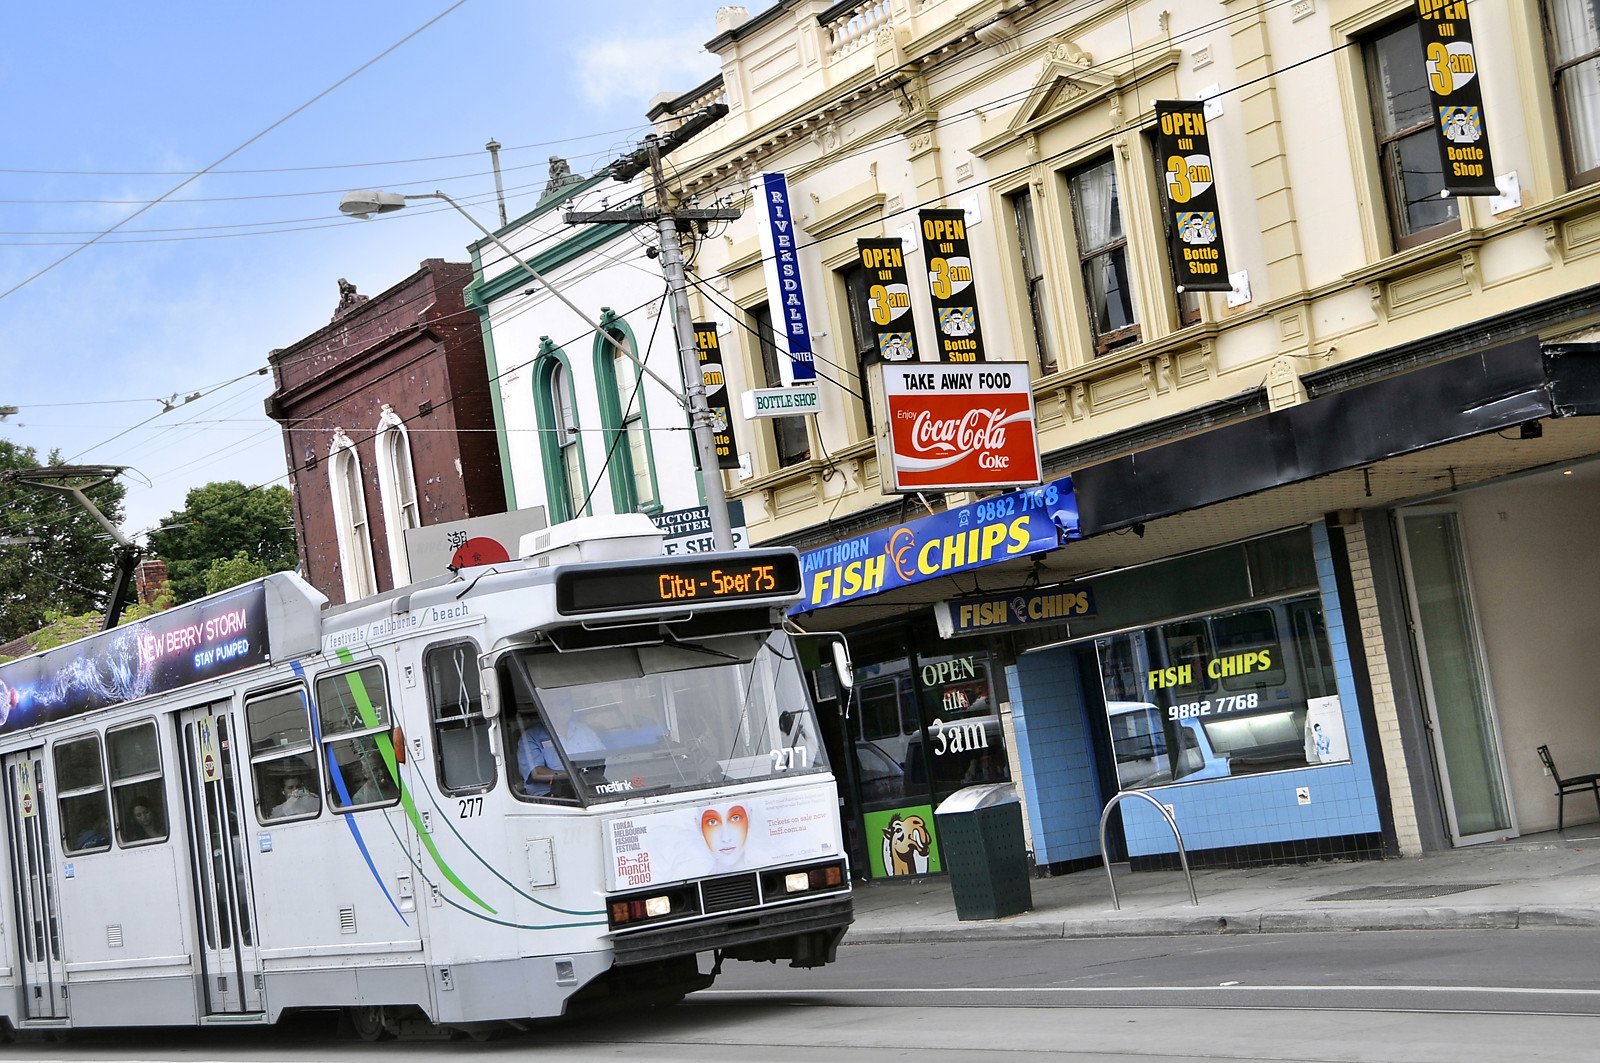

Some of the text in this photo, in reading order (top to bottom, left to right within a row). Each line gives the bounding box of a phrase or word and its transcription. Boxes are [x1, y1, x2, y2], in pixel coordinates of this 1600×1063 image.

[1419, 0, 1467, 19] OPEN
[1438, 23, 1454, 36] till
[1161, 112, 1205, 136] OPEN
[1177, 138, 1193, 150] till
[1447, 146, 1483, 161] Bottle
[1453, 162, 1483, 177] Shop
[923, 219, 965, 240] OPEN
[940, 242, 954, 253] till
[1183, 247, 1218, 260] Bottle
[771, 191, 804, 335] RIVERSDALE
[862, 248, 903, 268] OPEN
[878, 270, 892, 280] till
[1188, 261, 1218, 275] Shop
[694, 332, 718, 349] PEN
[944, 339, 977, 351] Bottle
[790, 352, 813, 362] HOTEL
[949, 351, 977, 362] Shop
[703, 372, 723, 385] am
[903, 372, 1011, 390] TAKE AWAY FOOD
[756, 393, 817, 409] BOTTLE SHOP
[897, 410, 917, 420] Enjoy
[912, 408, 1007, 452] Coca-Cola
[978, 451, 1010, 469] Coke
[976, 497, 1015, 524] 9882
[661, 519, 710, 534] BITTER
[447, 530, 469, 551] 潮
[686, 533, 742, 553] SHP
[918, 516, 1030, 575] CHIPS
[659, 574, 696, 599] City
[812, 554, 886, 605] FISH
[960, 592, 1088, 628] FISH CHIPS
[330, 627, 364, 648] festivals
[432, 602, 469, 621] beach
[138, 609, 247, 663] NEW BERRY STORM
[194, 639, 249, 667] STAY PUMPED
[922, 656, 975, 686] OPEN
[1148, 649, 1271, 690] FISH CHIPS
[942, 690, 962, 711] till
[1168, 693, 1258, 720] 9882 7768
[928, 718, 989, 756] 3am
[769, 745, 807, 770] 277
[595, 779, 634, 794] metlink
[458, 797, 484, 818] 277
[767, 816, 790, 827] Tickets
[800, 813, 812, 822] sale
[614, 826, 648, 838] MELBOURNE
[615, 835, 639, 846] FASHION
[616, 842, 641, 853] FESTIVAL
[628, 873, 651, 886] 2009
